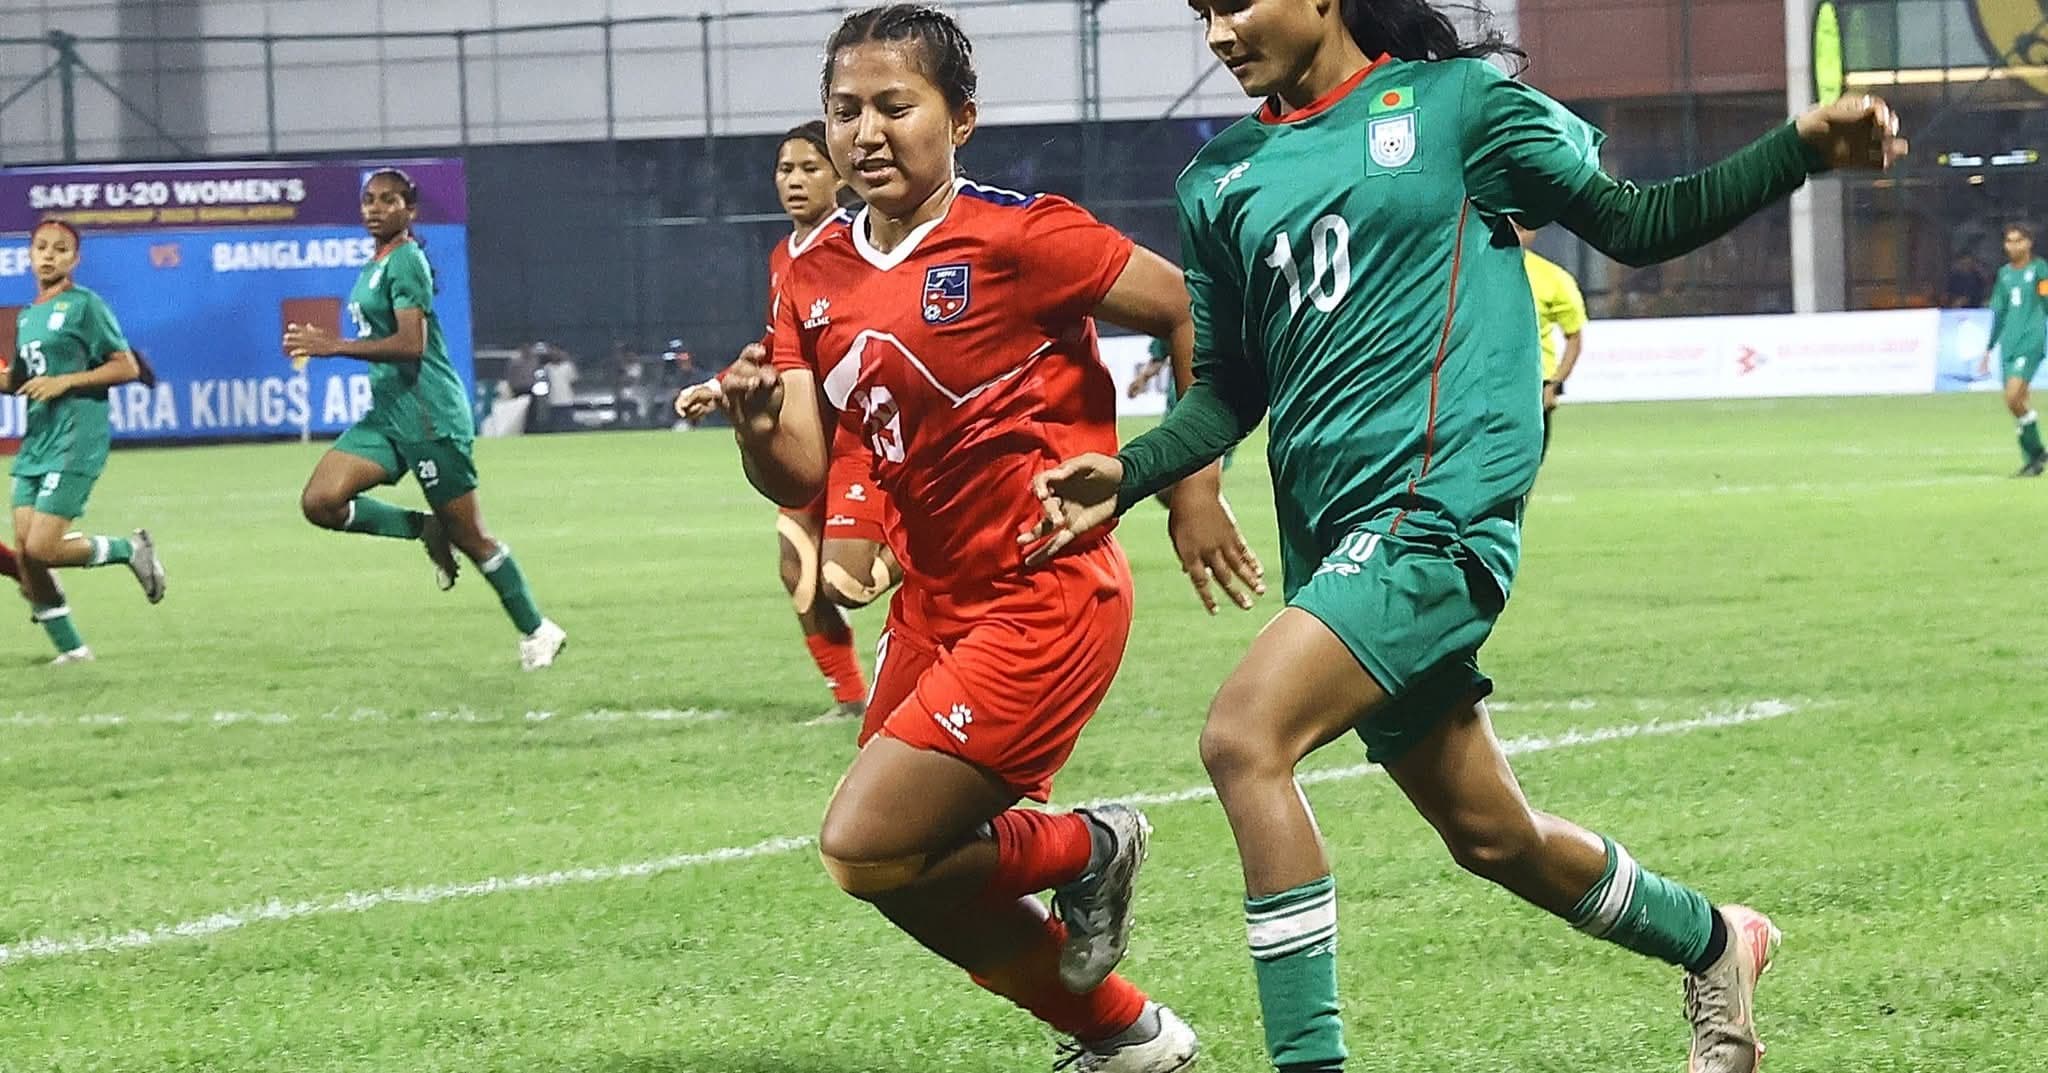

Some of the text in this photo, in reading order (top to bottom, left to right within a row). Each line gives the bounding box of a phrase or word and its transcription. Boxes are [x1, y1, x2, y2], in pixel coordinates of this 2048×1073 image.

[29, 178, 306, 208] SAFF U-20 WOMEN'S
[150, 243, 181, 267] VS
[1264, 213, 1351, 317] 10
[20, 340, 47, 376] 15
[190, 375, 310, 429] KINGS
